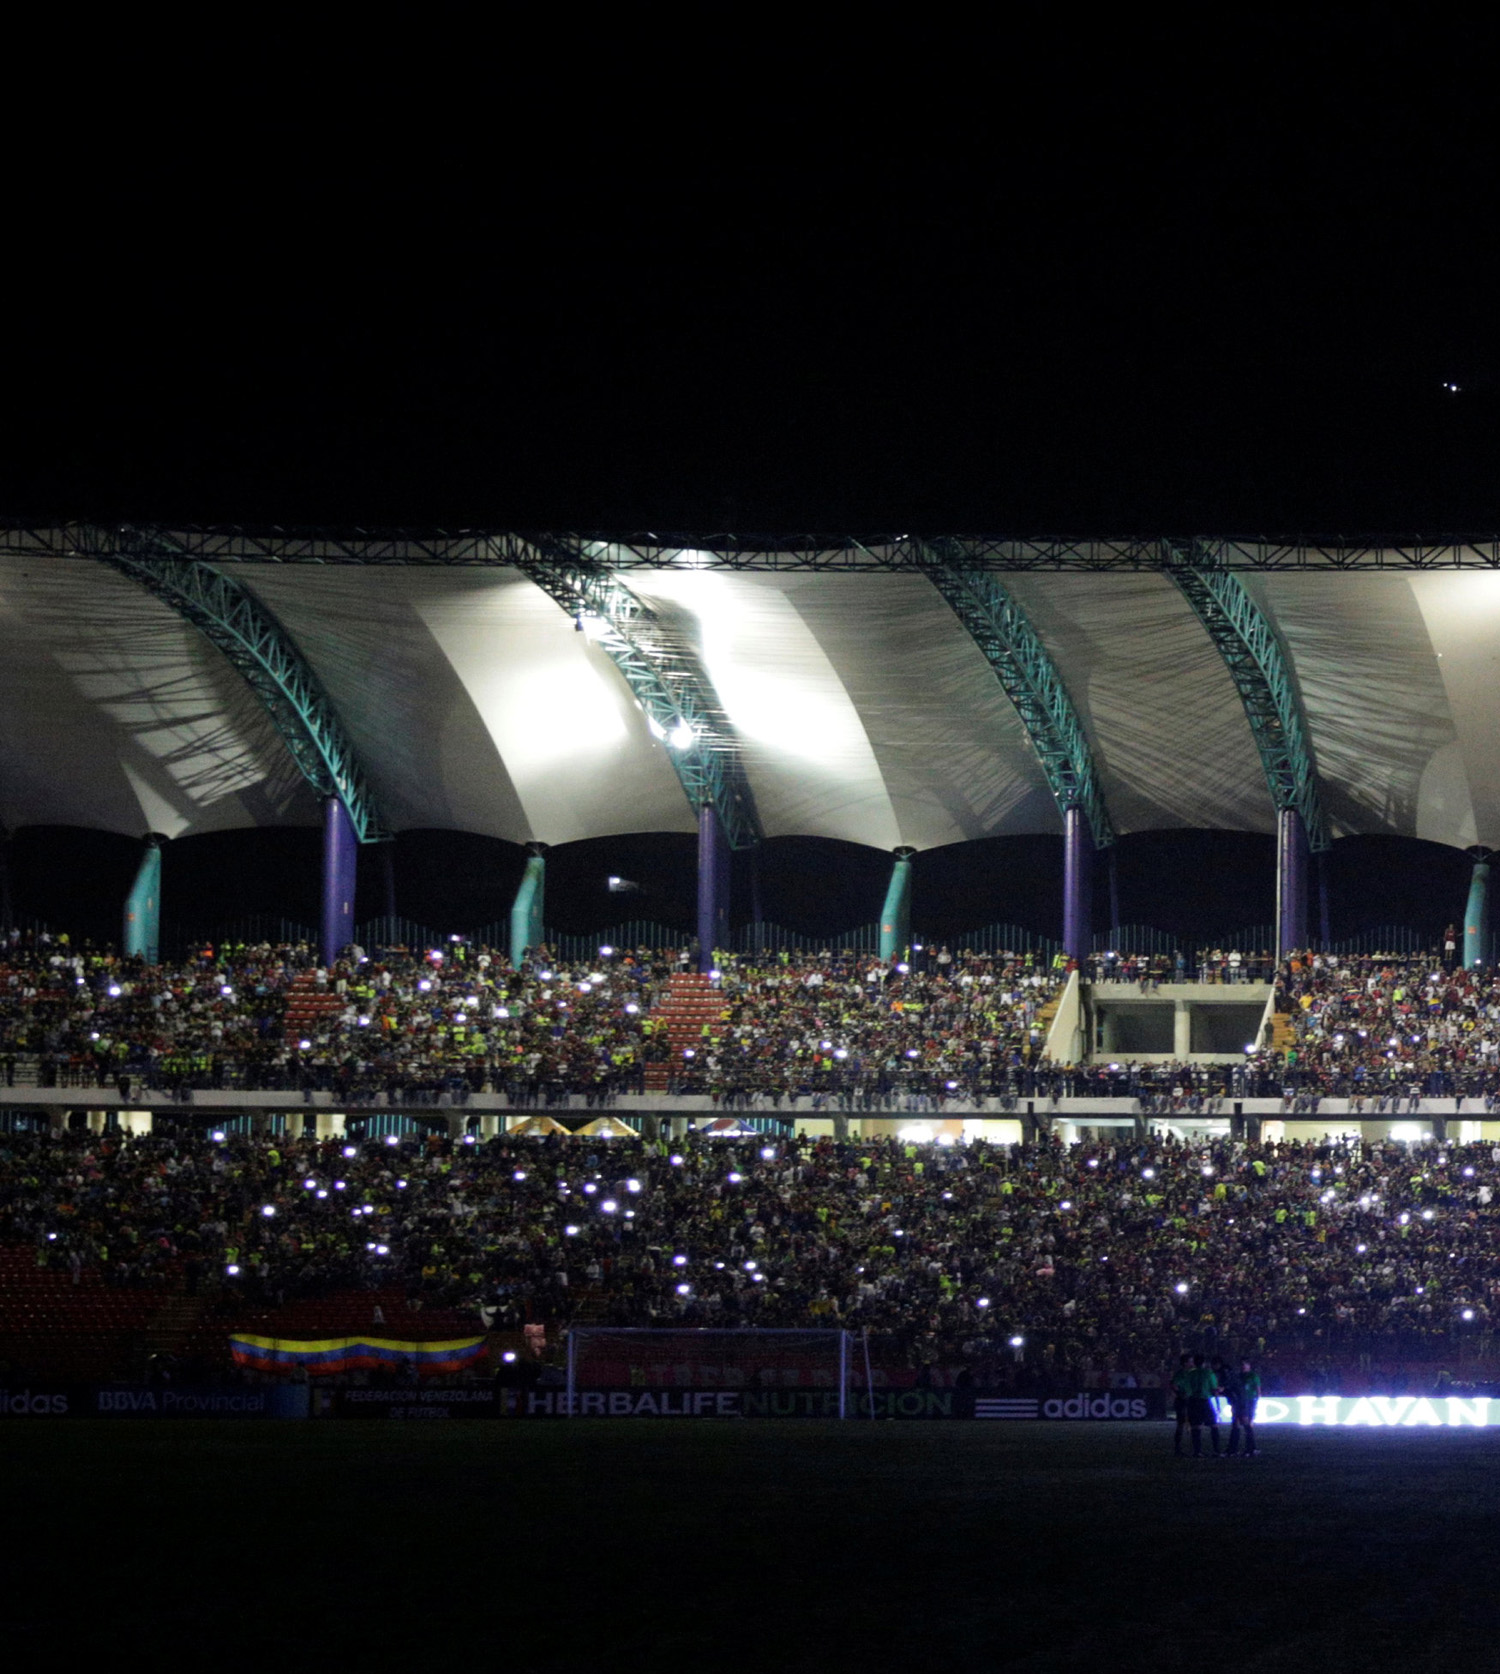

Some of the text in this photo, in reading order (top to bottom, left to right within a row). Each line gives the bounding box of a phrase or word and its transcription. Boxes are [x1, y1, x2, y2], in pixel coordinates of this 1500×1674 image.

[0, 1388, 69, 1414] idas
[98, 1390, 265, 1412] BBVA Provincial
[419, 1390, 494, 1403] VENEZOLANA
[527, 1391, 740, 1416] HERBALIFE
[1043, 1392, 1148, 1419] adidas
[1296, 1395, 1492, 1427] HAVAN
